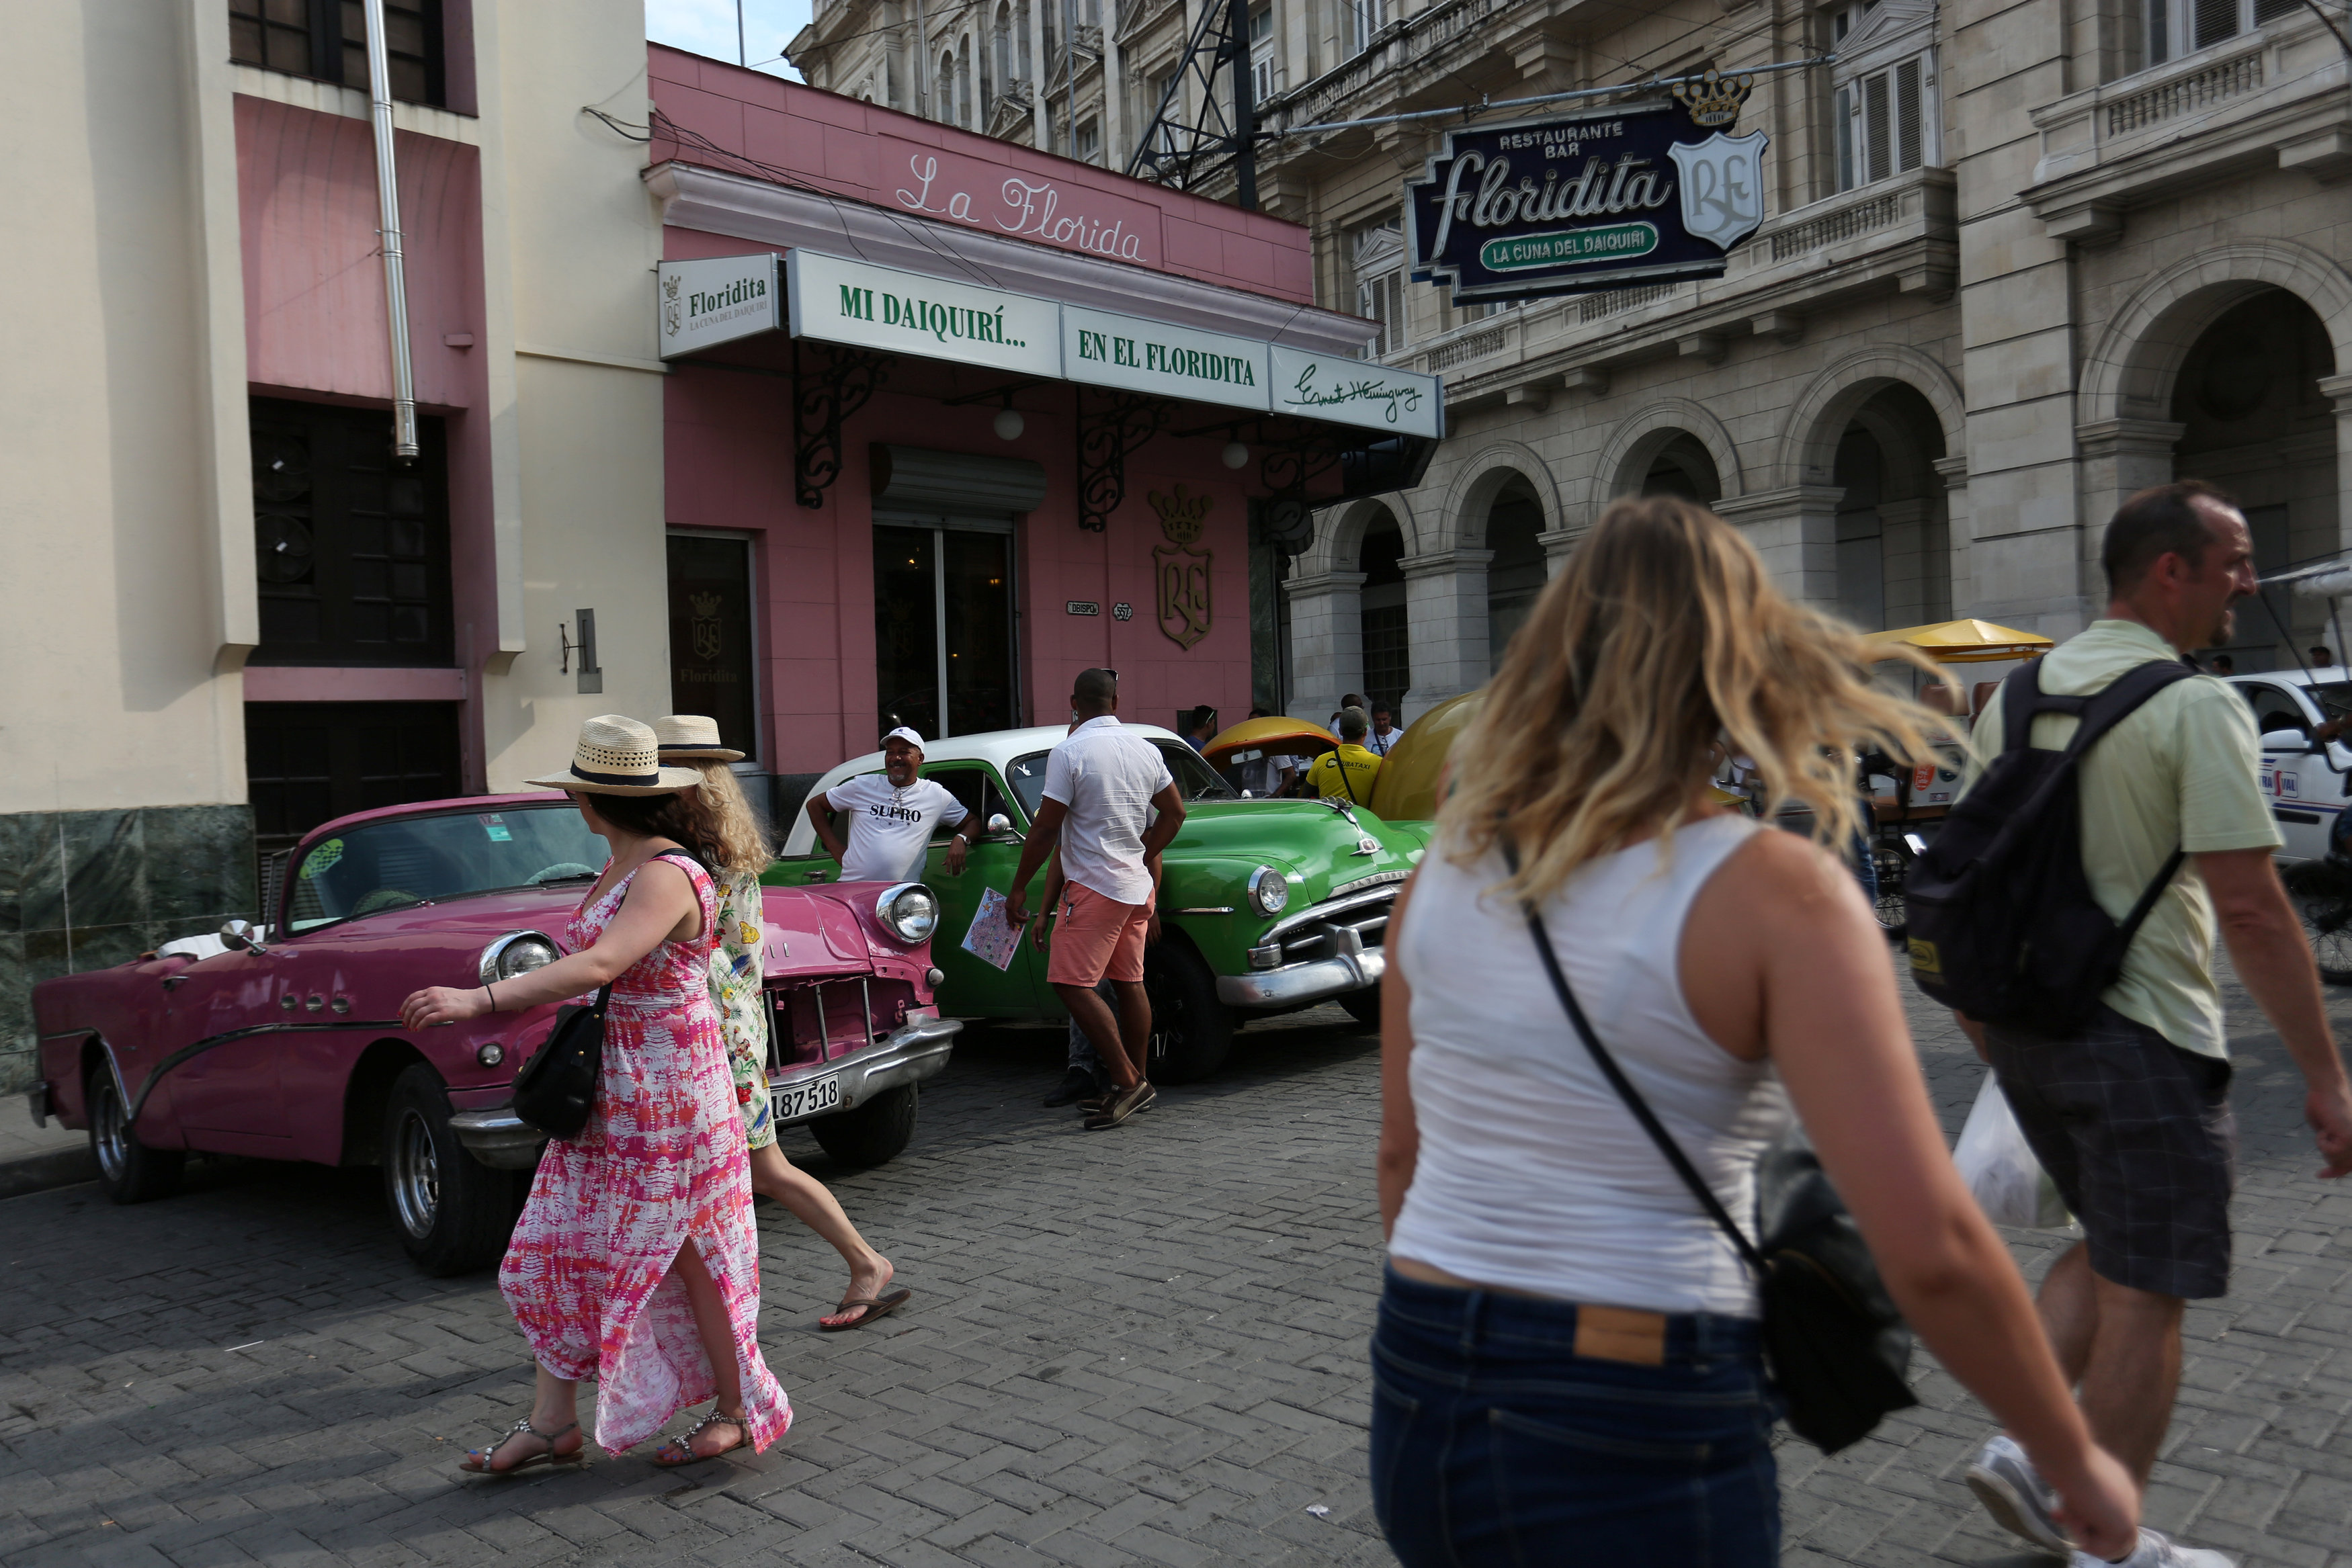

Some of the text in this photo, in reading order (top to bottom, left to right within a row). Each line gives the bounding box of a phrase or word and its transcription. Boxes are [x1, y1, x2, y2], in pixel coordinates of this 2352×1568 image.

[1499, 121, 1624, 150] RESTAURANTE
[1545, 142, 1581, 159] BAR
[896, 155, 1146, 262] La Florida
[1493, 230, 1645, 263] LA CUNA DEL DAIQUIRI
[689, 277, 766, 317] Floridita
[840, 284, 873, 321] MI
[689, 322, 700, 331] LA
[700, 316, 718, 328] CUNA
[720, 310, 732, 322] DEL
[1079, 329, 1255, 387] EN EL FLORIDITA
[1073, 604, 1095, 613] OBISPO
[1117, 607, 1130, 617] 557
[680, 669, 737, 683] Floridita
[870, 805, 921, 823] SUPRO
